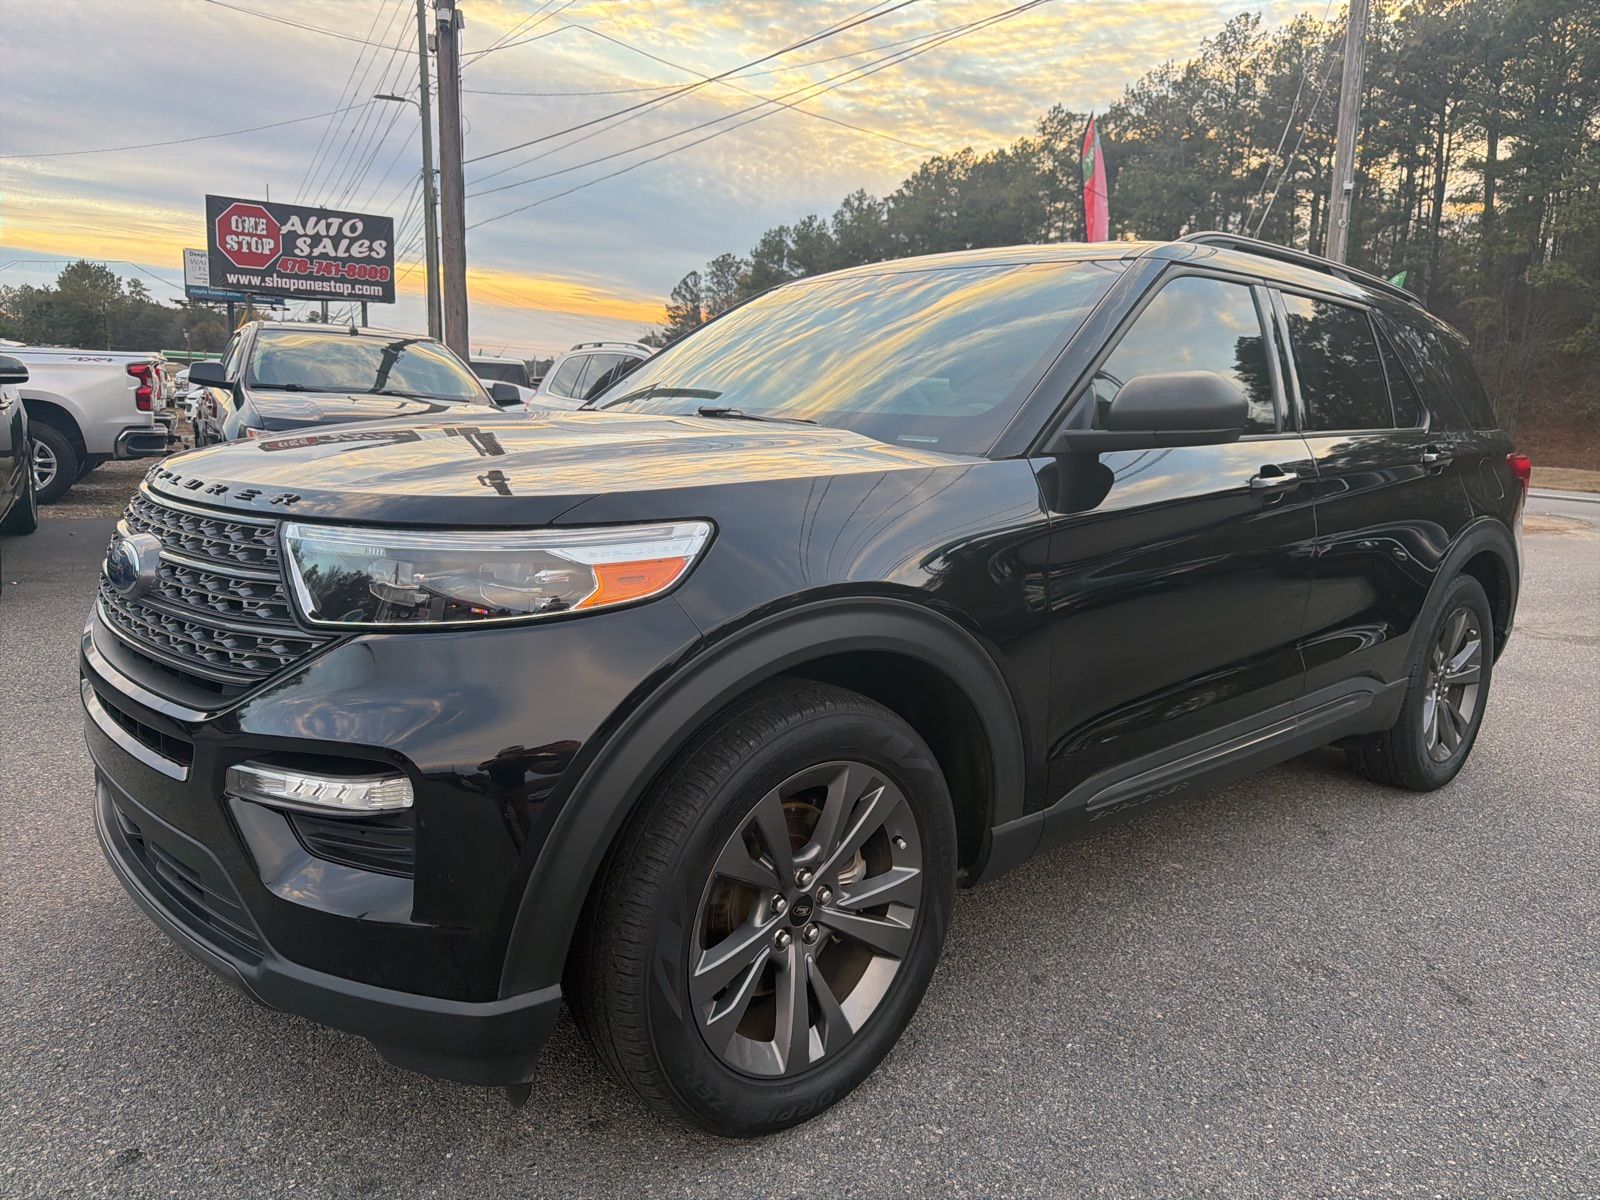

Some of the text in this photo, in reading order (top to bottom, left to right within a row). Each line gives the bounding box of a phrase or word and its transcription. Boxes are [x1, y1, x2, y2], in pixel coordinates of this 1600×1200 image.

[231, 215, 267, 235] ONE
[280, 215, 363, 237] AUTO
[226, 235, 275, 255] STOP
[226, 273, 383, 297] www.shoponestop.com
